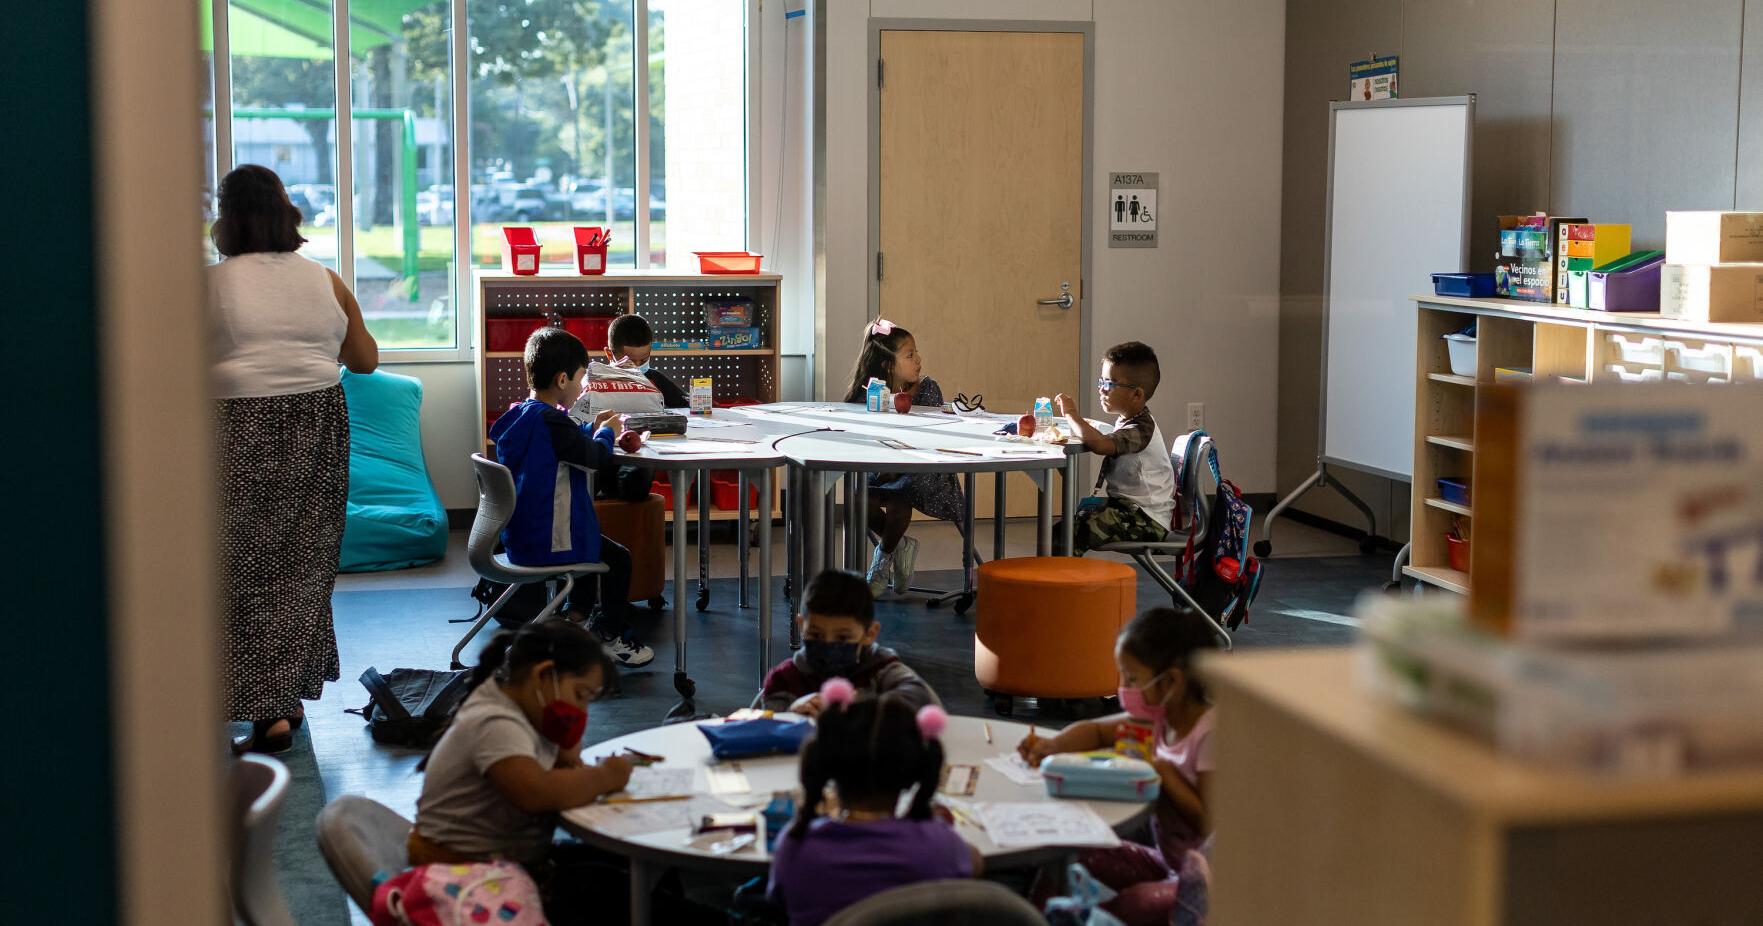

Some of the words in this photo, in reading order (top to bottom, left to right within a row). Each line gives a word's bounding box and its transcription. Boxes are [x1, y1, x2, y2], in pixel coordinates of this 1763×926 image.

[1113, 174, 1145, 185] A137A
[1112, 233, 1154, 241] RESTROOM
[1510, 263, 1537, 275] Vecinos
[1523, 276, 1550, 288] espacio
[611, 381, 634, 390] THIS
